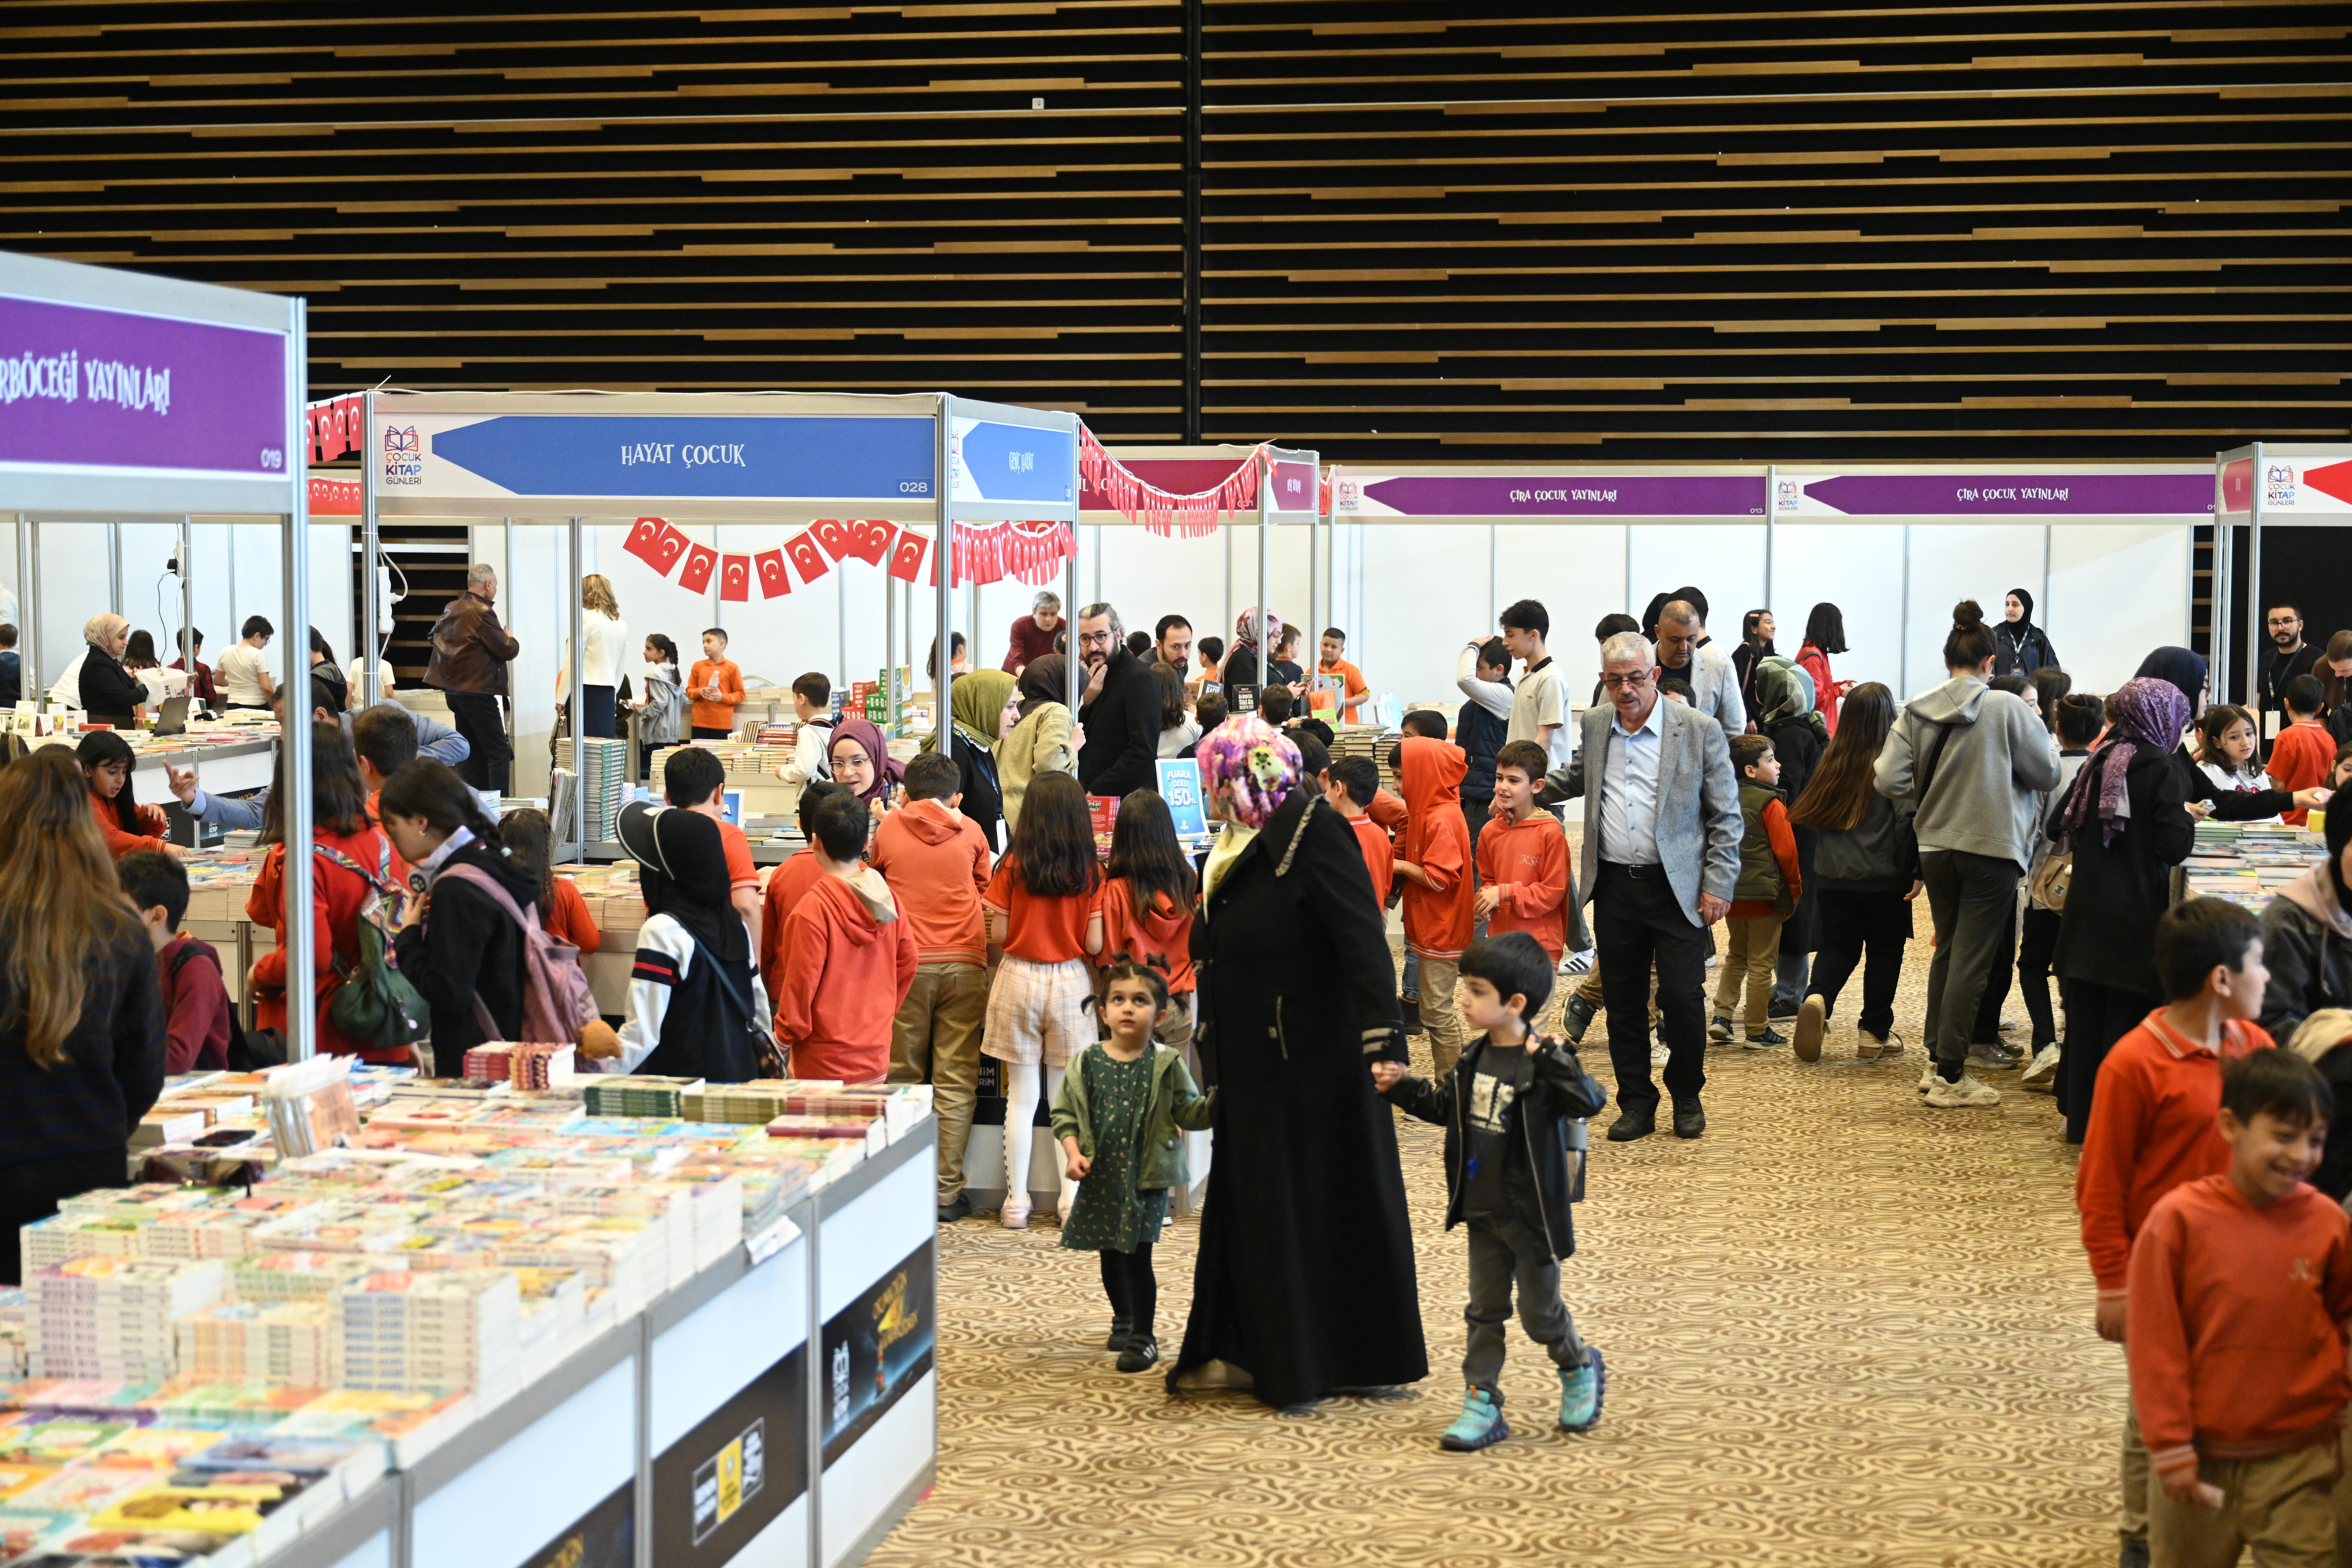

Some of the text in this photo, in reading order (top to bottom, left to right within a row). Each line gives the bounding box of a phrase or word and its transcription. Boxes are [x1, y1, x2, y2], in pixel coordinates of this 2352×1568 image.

[0, 349, 171, 416] RBÖCEĞİ YAYINLARI
[261, 448, 282, 469] 019
[386, 453, 421, 463] ÇOCUK
[621, 443, 746, 468] HAYAT ÇOCUK
[386, 462, 422, 476] KİTAP
[1009, 451, 1034, 474] GENÇ HAYAT
[386, 476, 421, 485] GÜNLERİ
[899, 482, 928, 492] 028
[1510, 489, 1617, 503] ÇIRA ÇOCUK YAYINLARI
[1957, 488, 2069, 501] ÇIRA ÇOCUK YAYINLARI
[2268, 490, 2295, 499] KİTAP
[1167, 770, 1192, 781] FUARA
[1173, 779, 1188, 787] ÖZEL
